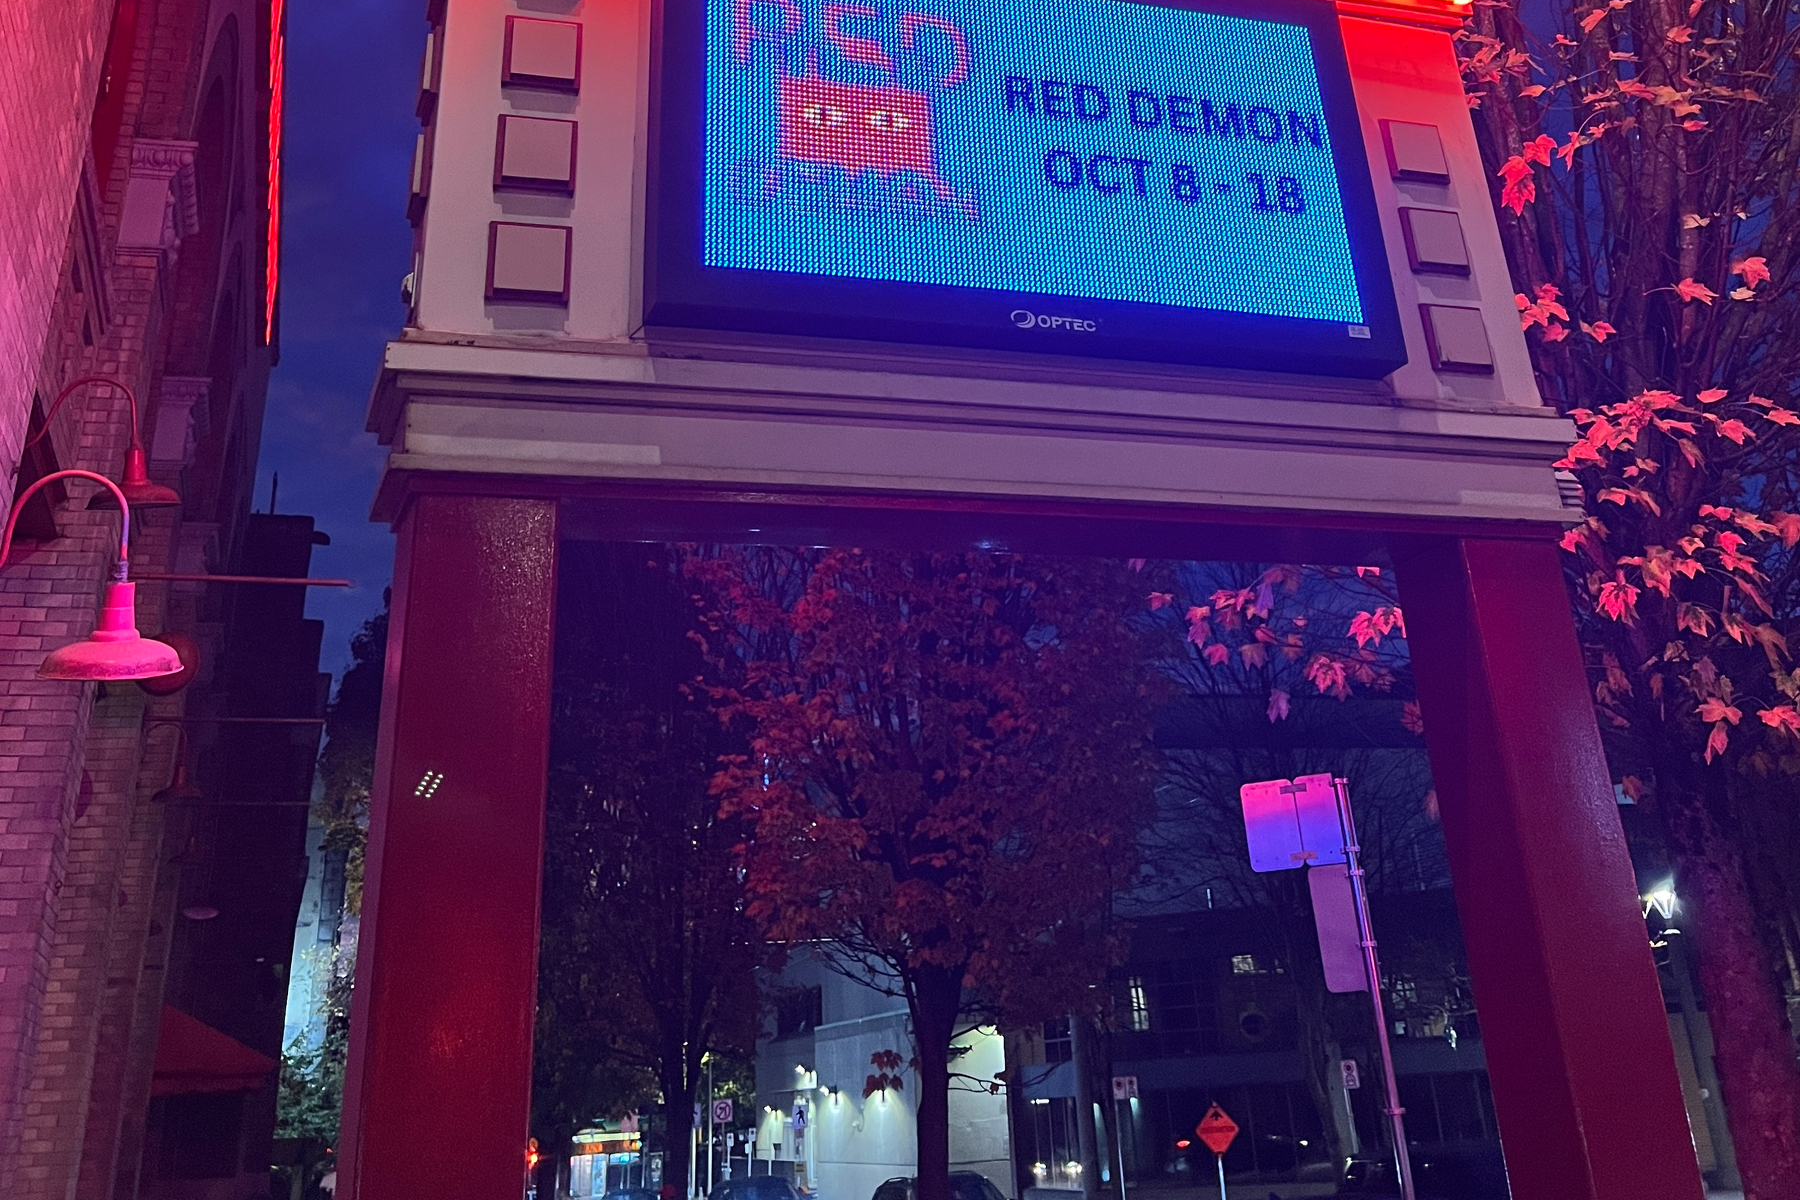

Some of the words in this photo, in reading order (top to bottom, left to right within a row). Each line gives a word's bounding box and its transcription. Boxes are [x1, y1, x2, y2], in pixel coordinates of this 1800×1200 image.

[1004, 74, 1108, 122] RED
[1127, 88, 1322, 149] DEMON
[1044, 149, 1150, 197] OCT
[1172, 163, 1201, 204] 8
[1250, 171, 1304, 215] 18
[1037, 314, 1097, 332] OPTEC
